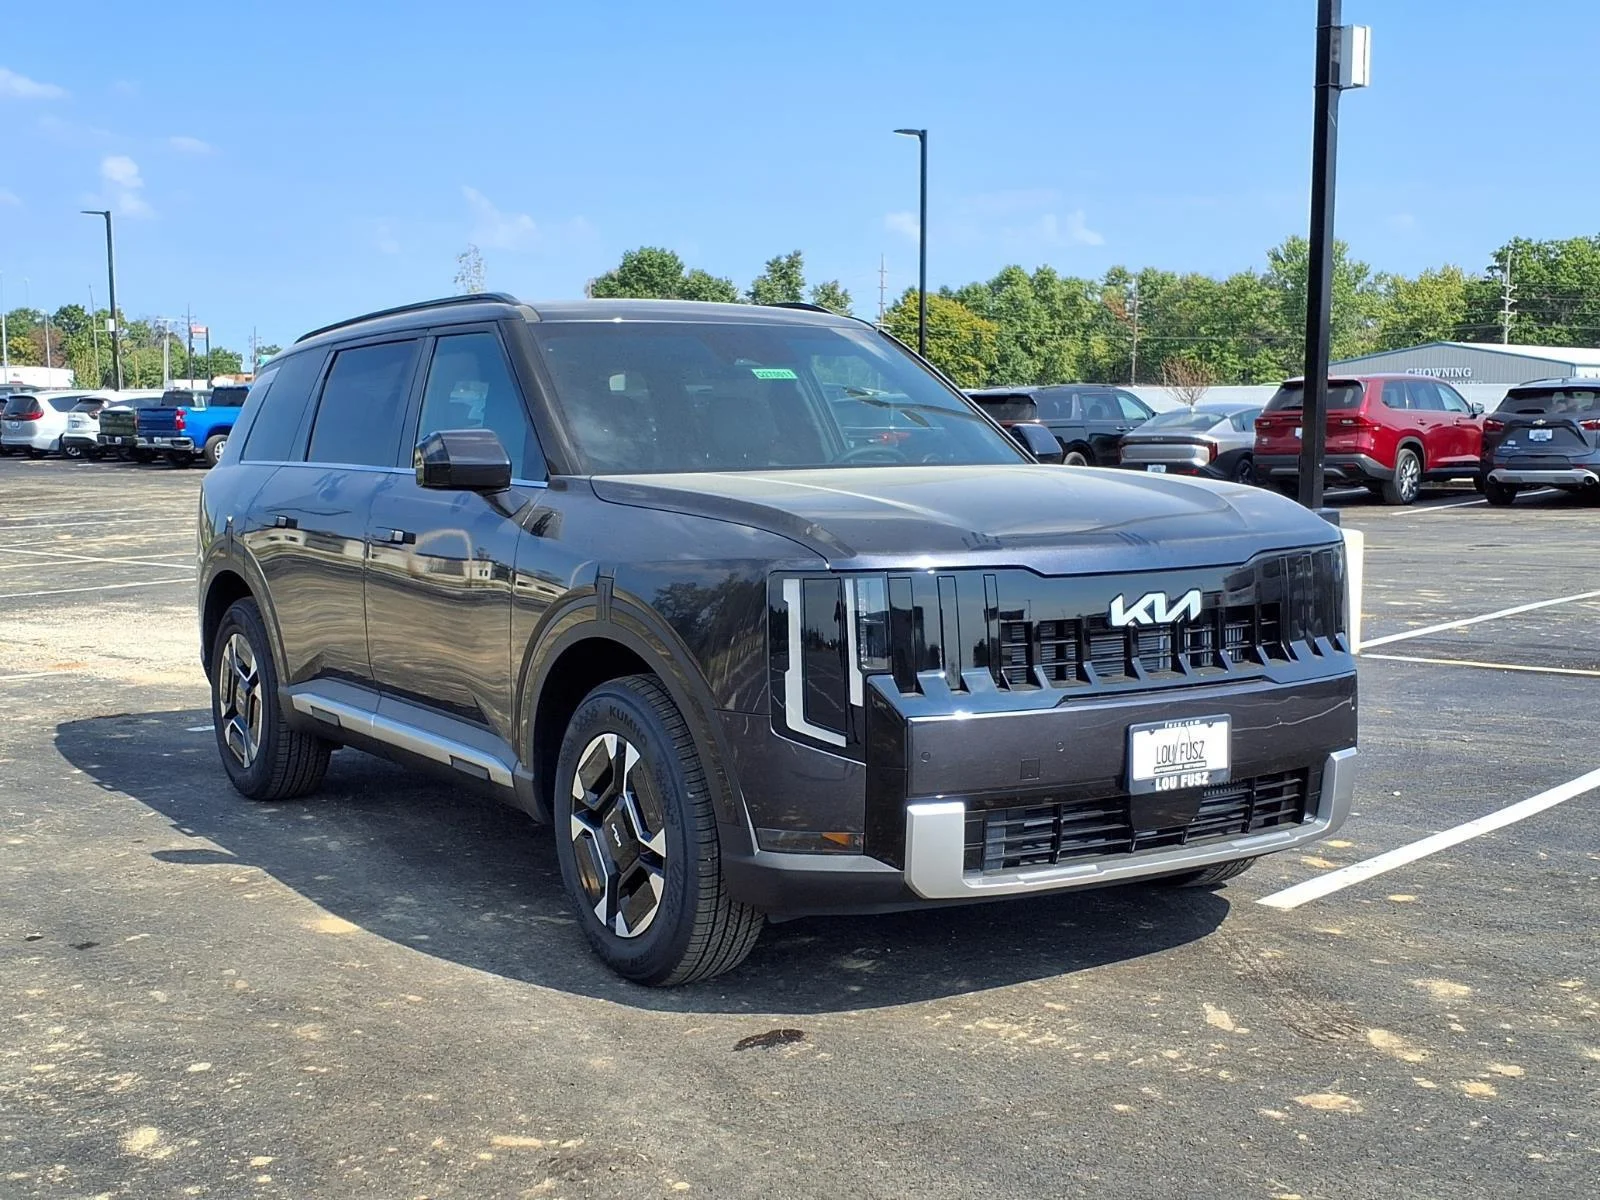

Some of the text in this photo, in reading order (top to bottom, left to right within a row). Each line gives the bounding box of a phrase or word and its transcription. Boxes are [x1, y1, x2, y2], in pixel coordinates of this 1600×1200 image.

[1406, 367, 1472, 377] CHOWNING
[1110, 589, 1202, 626] KIA
[609, 705, 647, 746] KUMHO
[1179, 740, 1205, 761] FUSZ
[1155, 771, 1209, 791] LOU FUSZ
